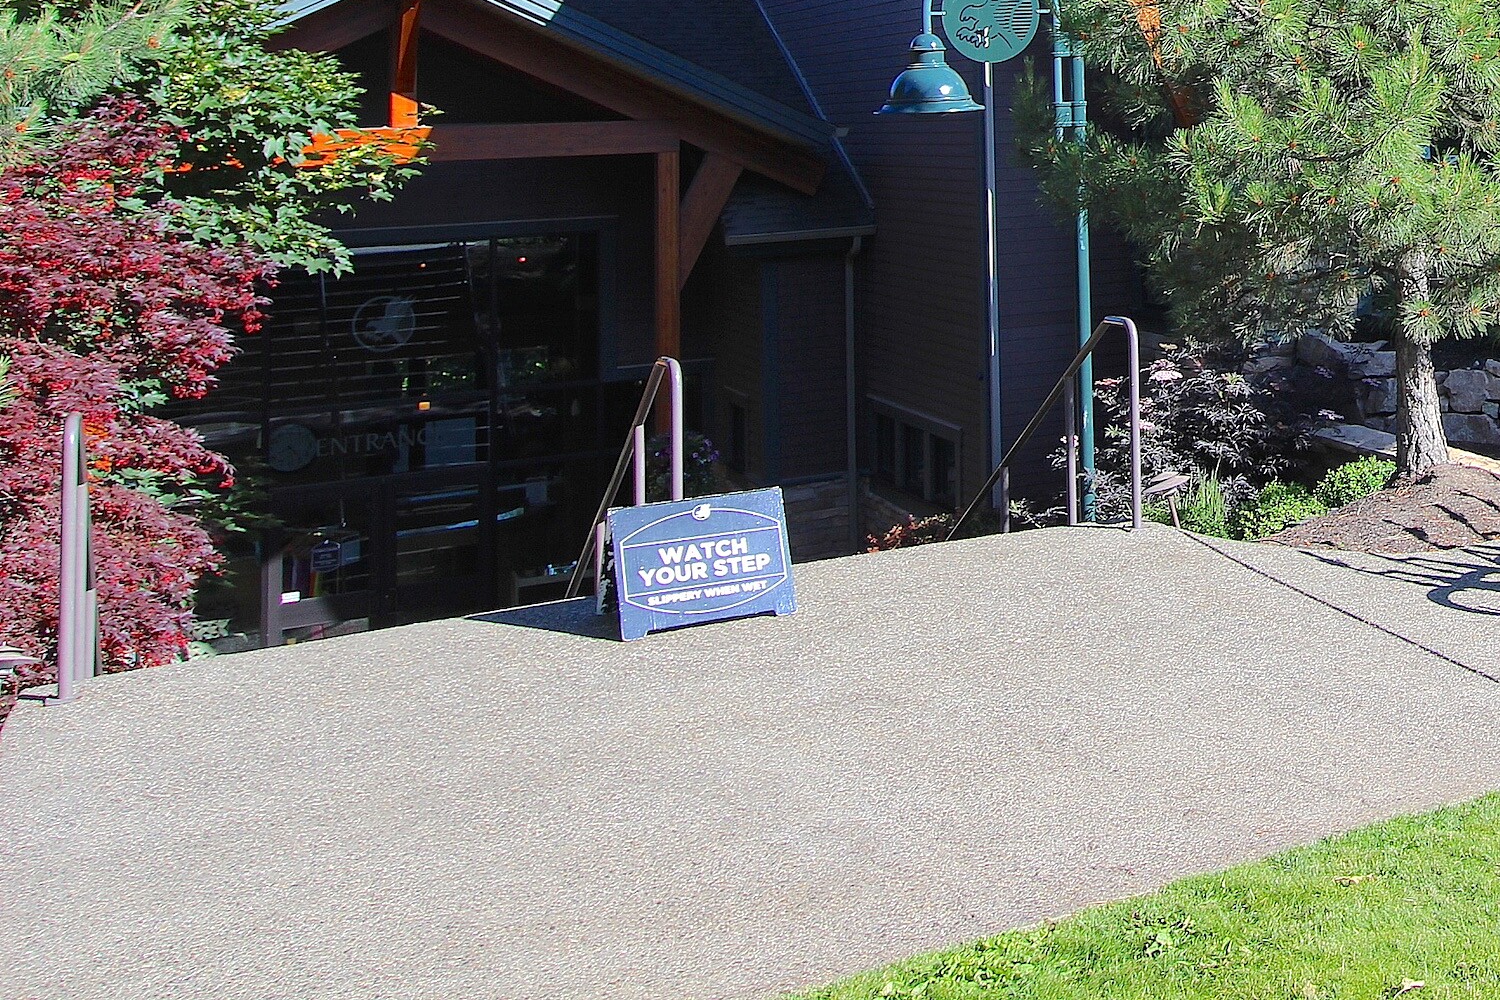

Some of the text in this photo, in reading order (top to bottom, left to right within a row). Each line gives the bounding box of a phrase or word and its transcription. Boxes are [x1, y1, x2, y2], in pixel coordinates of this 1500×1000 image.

[658, 537, 748, 565] WATCH
[638, 553, 771, 587] YOUR STEP
[648, 580, 768, 606] SLIPPERY WHEN WET
